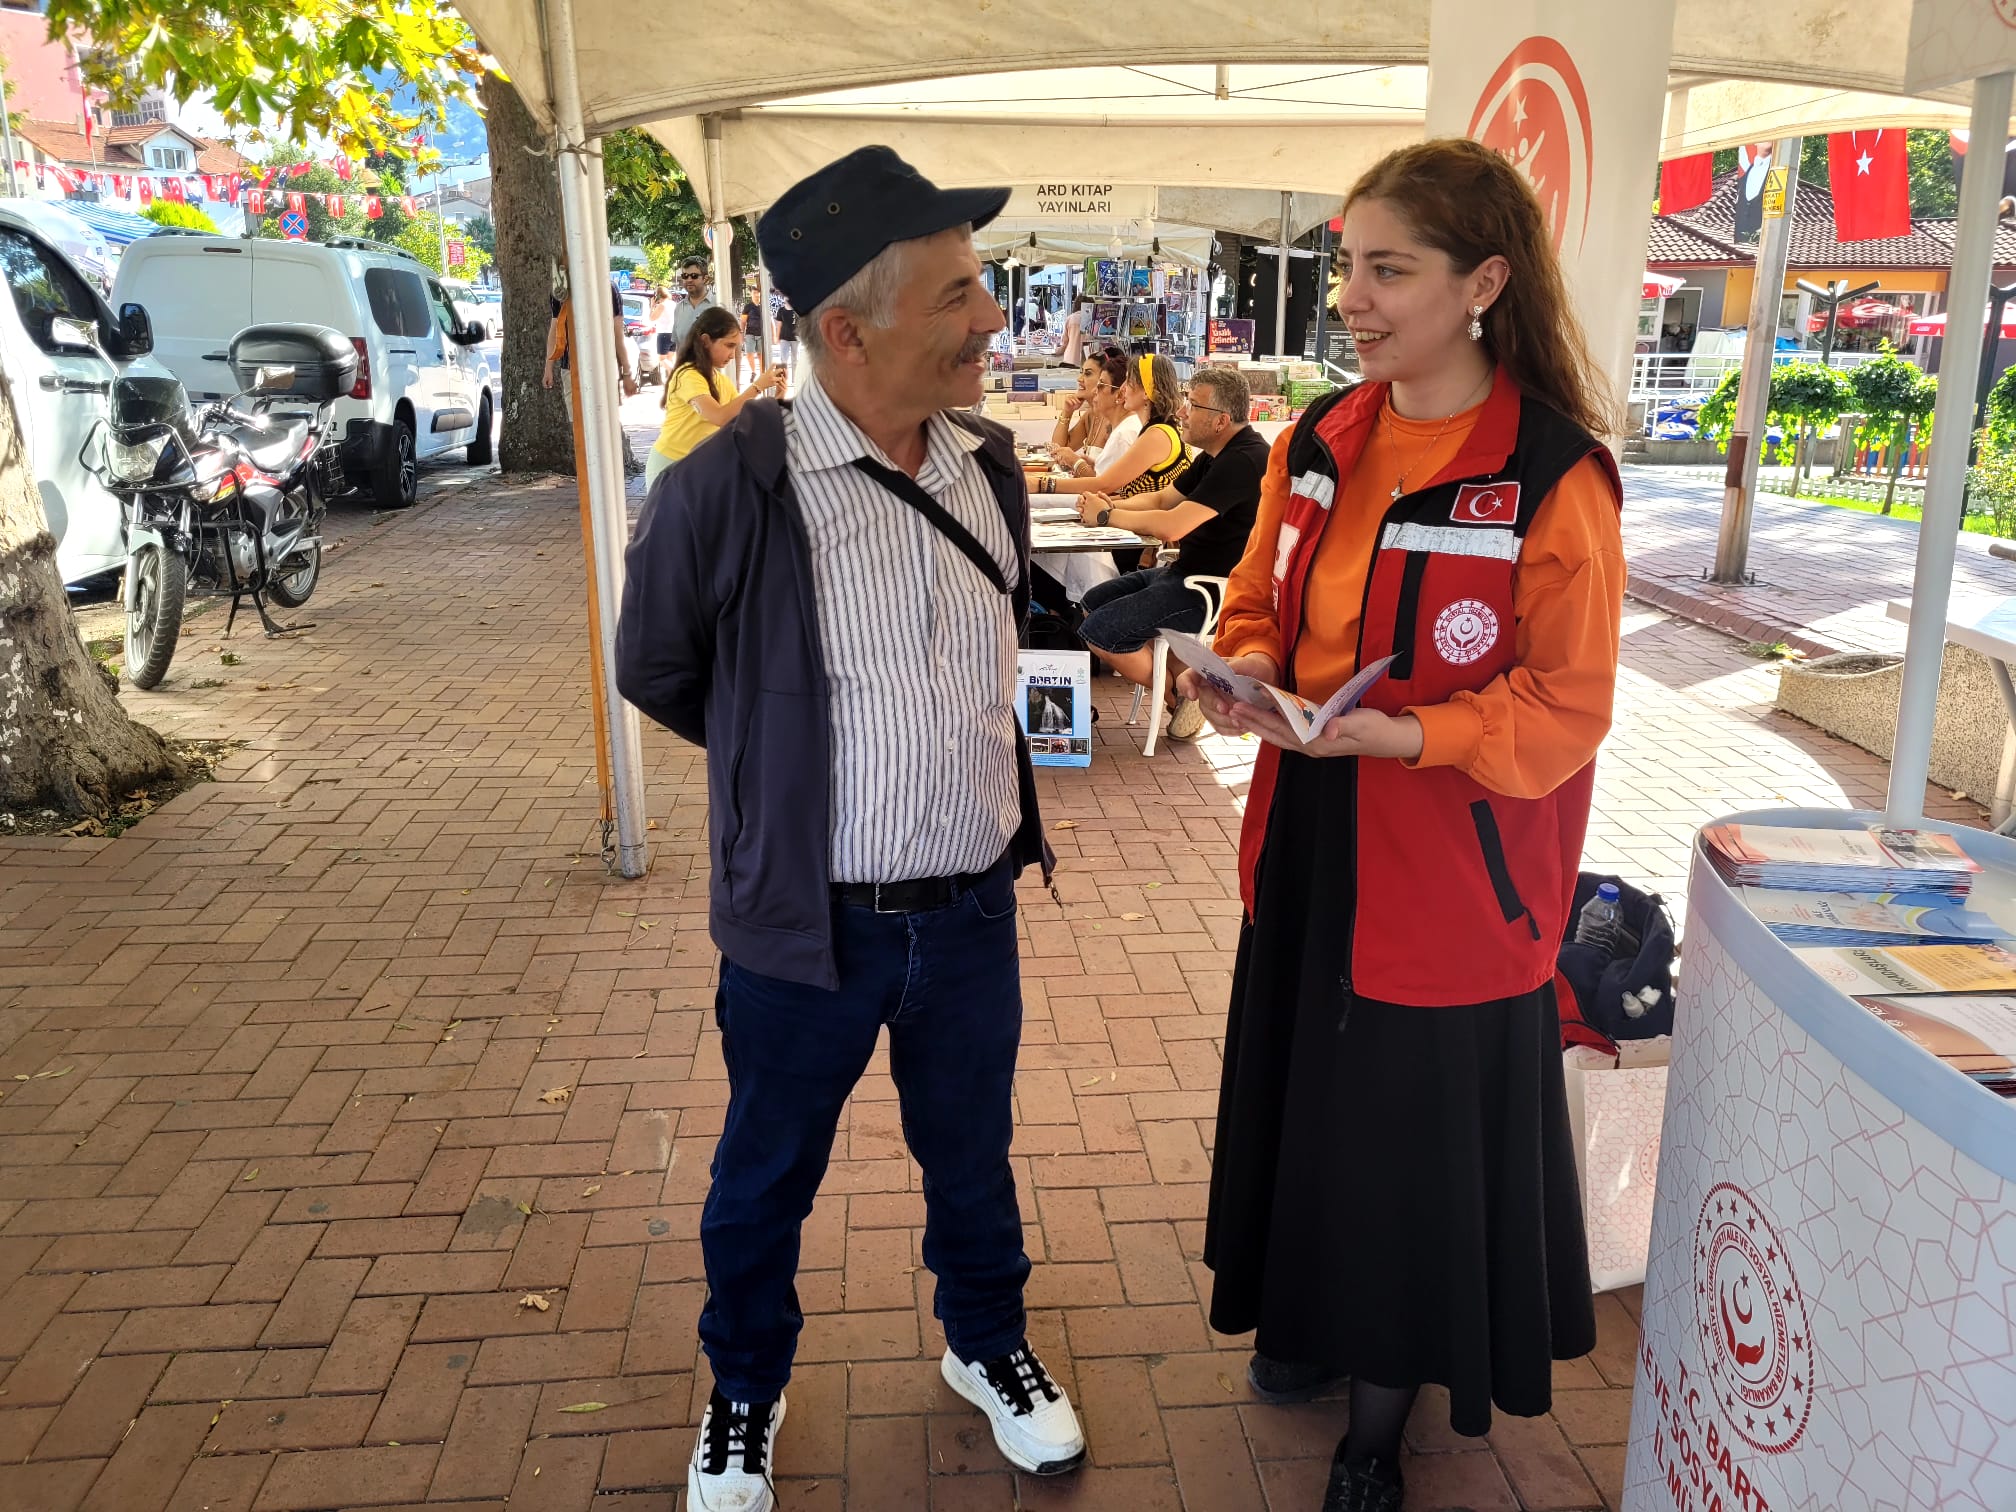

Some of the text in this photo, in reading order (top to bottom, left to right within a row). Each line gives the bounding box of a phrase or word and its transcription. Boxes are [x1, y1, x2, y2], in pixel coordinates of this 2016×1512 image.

[1036, 184, 1067, 197] ARD
[1038, 201, 1111, 213] YAYINLARI
[1029, 675, 1072, 686] BARTIN
[1708, 1226, 1787, 1403] TÜRKİYE CUMHURİYETİ AİLE VE SOSYAL HİZMETLER BAKANLIĞI
[1654, 1361, 1671, 1421] VE
[1653, 1418, 1665, 1475] İL
[1678, 1358, 1772, 1512] T.C. BART
